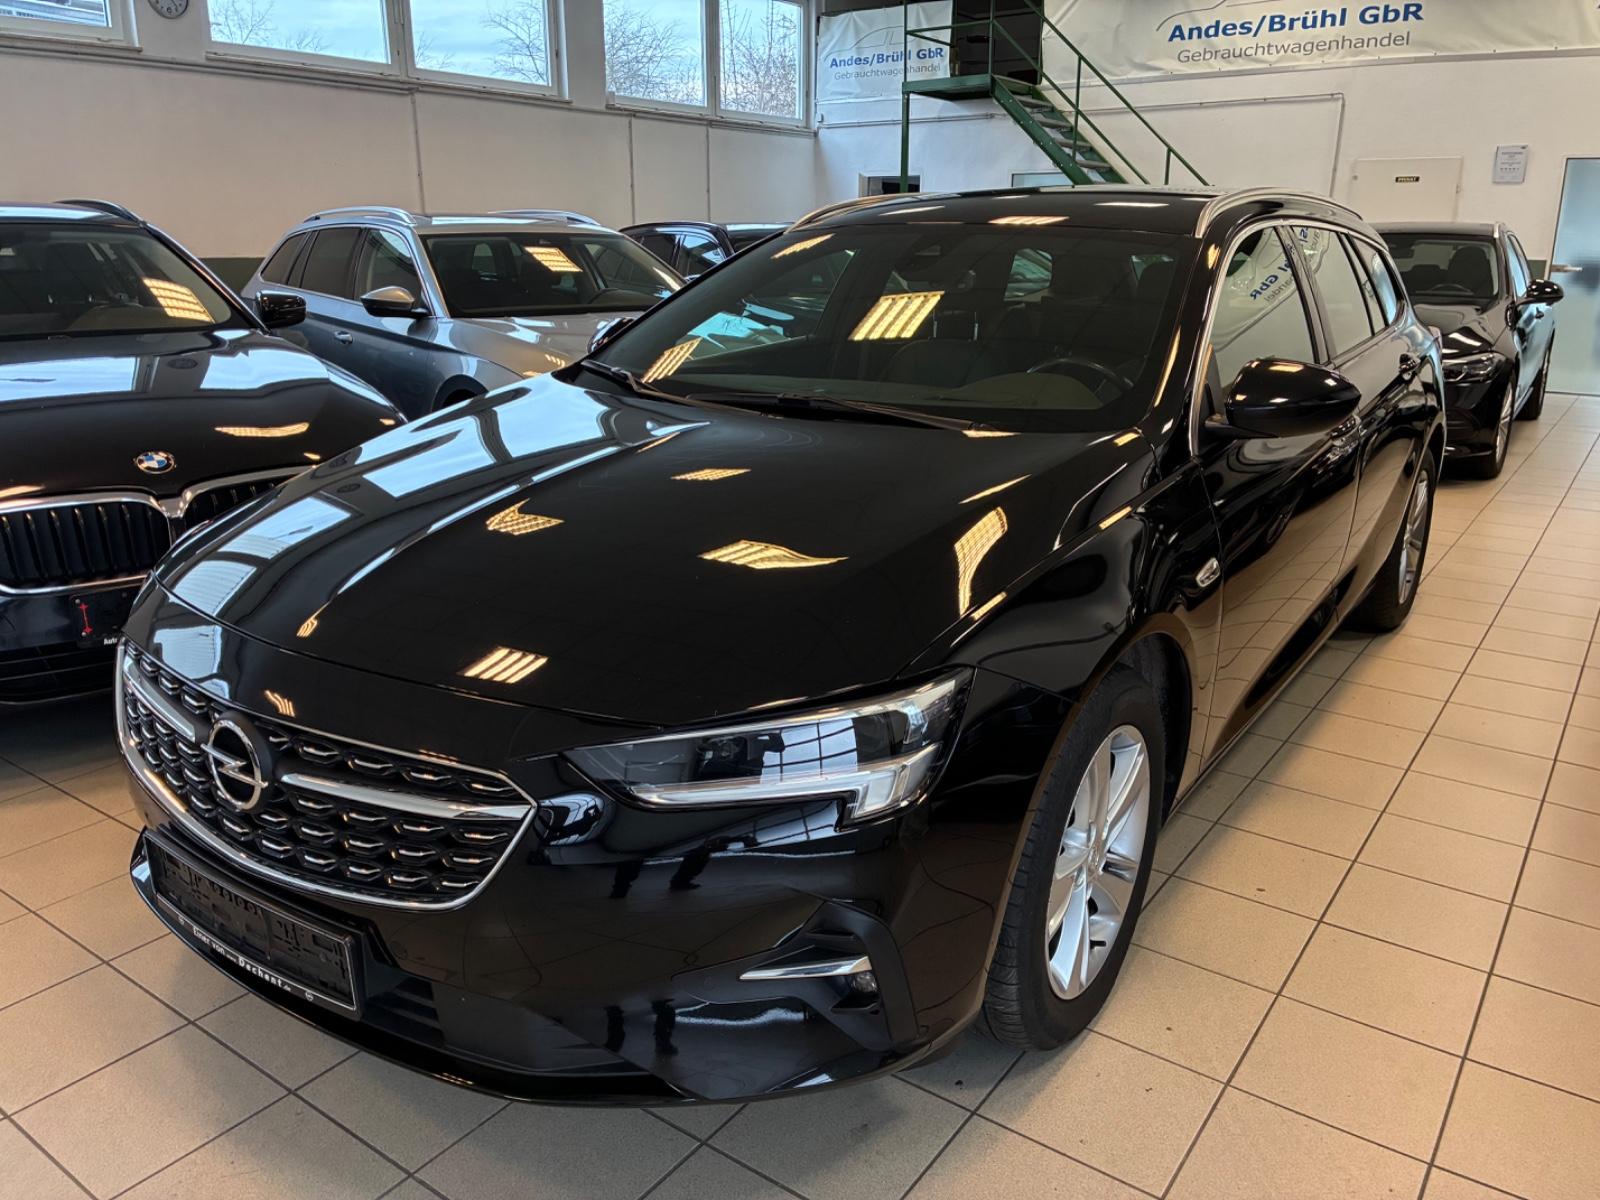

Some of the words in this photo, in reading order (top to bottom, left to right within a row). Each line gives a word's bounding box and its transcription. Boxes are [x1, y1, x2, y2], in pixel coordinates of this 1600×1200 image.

[1168, 8, 1347, 42] Andes/Brühl
[1359, 3, 1424, 25] GbR
[830, 51, 912, 68] Andes/Brühl
[916, 47, 944, 60] GbR
[1177, 31, 1411, 63] Gebrauchtwagenhandel
[834, 64, 941, 81] Gebrauchtwagehandel
